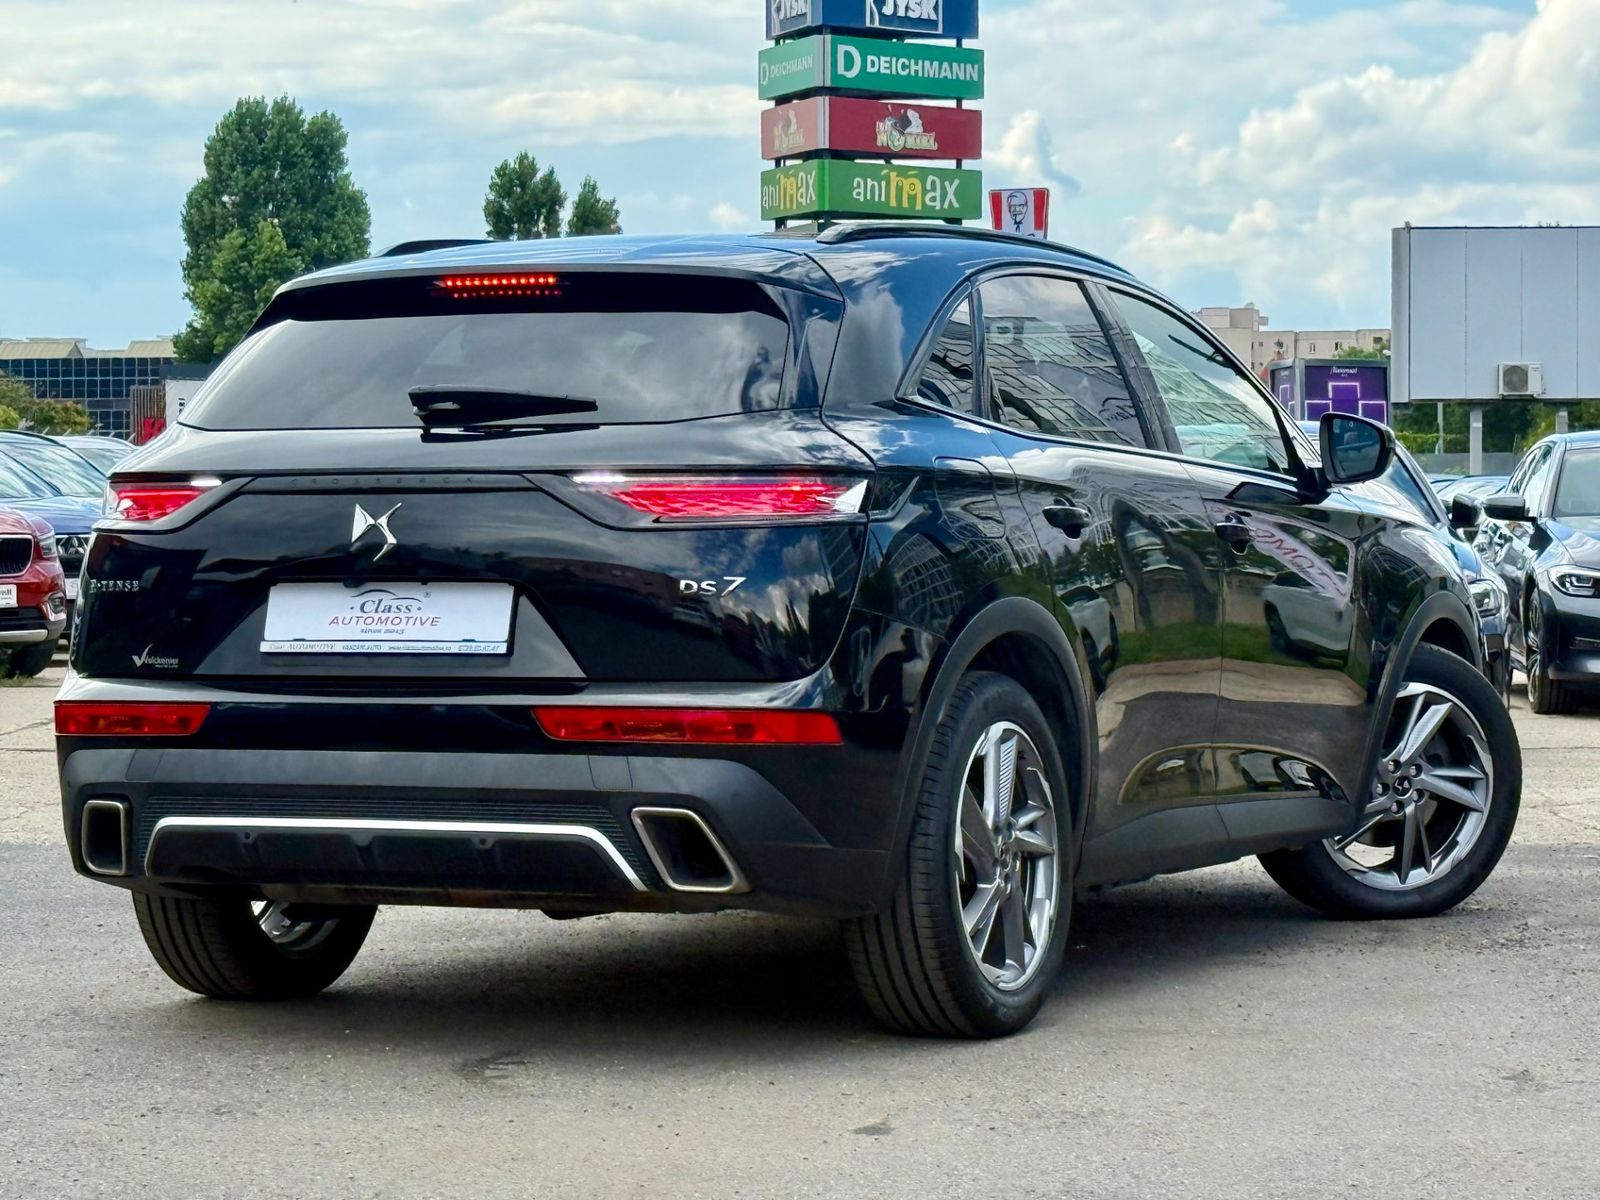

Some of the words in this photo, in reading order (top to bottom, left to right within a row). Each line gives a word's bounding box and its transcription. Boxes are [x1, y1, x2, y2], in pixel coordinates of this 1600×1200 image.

[881, 0, 938, 21] JYSK
[769, 55, 813, 78] DEICHMANN
[866, 55, 979, 82] DEICHMANN
[762, 170, 816, 210] animax
[853, 170, 960, 210] animax
[360, 599, 413, 614] Class
[328, 615, 441, 627] AUTOMOTIVE
